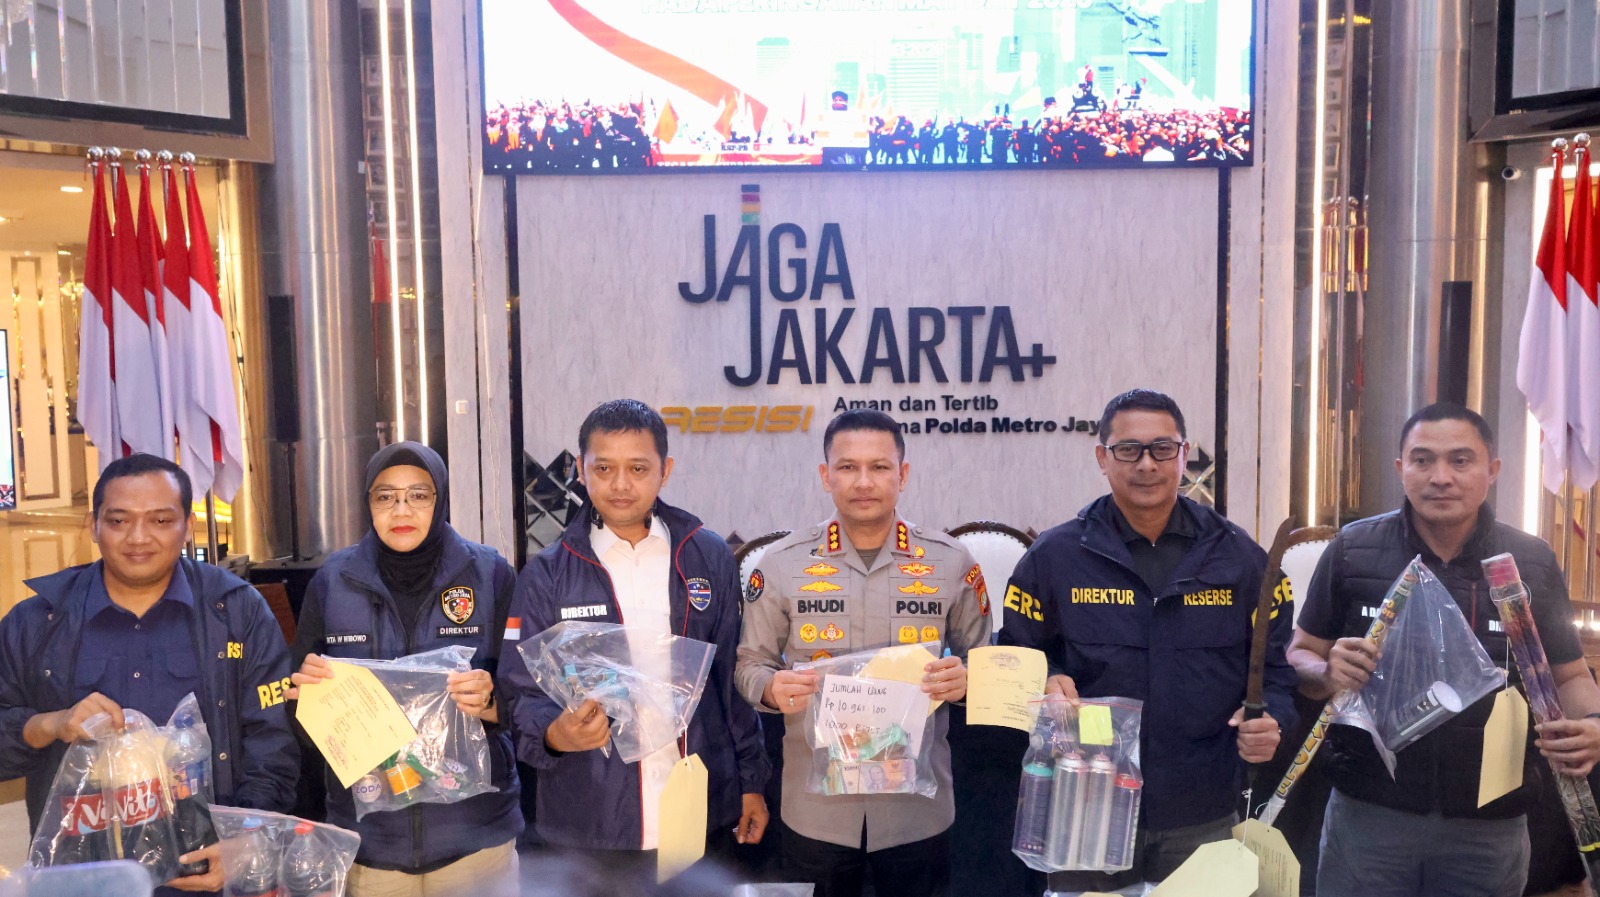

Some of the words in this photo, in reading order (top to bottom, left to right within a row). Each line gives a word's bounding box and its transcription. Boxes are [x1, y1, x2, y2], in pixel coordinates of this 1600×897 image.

[678, 213, 855, 303] JAGA
[833, 396, 892, 413] Aman
[899, 396, 936, 411] dan
[941, 394, 999, 412] Tertib
[925, 417, 987, 434] Polda
[991, 416, 1057, 433] Metro
[1071, 587, 1135, 606] DIREKTUR
[1184, 589, 1233, 606] RESERSE
[560, 604, 607, 619] DIREKTUR
[797, 599, 845, 613] BHUDI
[896, 600, 942, 615] POLRI
[440, 626, 479, 635] DIREKTUR
[830, 683, 861, 694] JUMLAH
